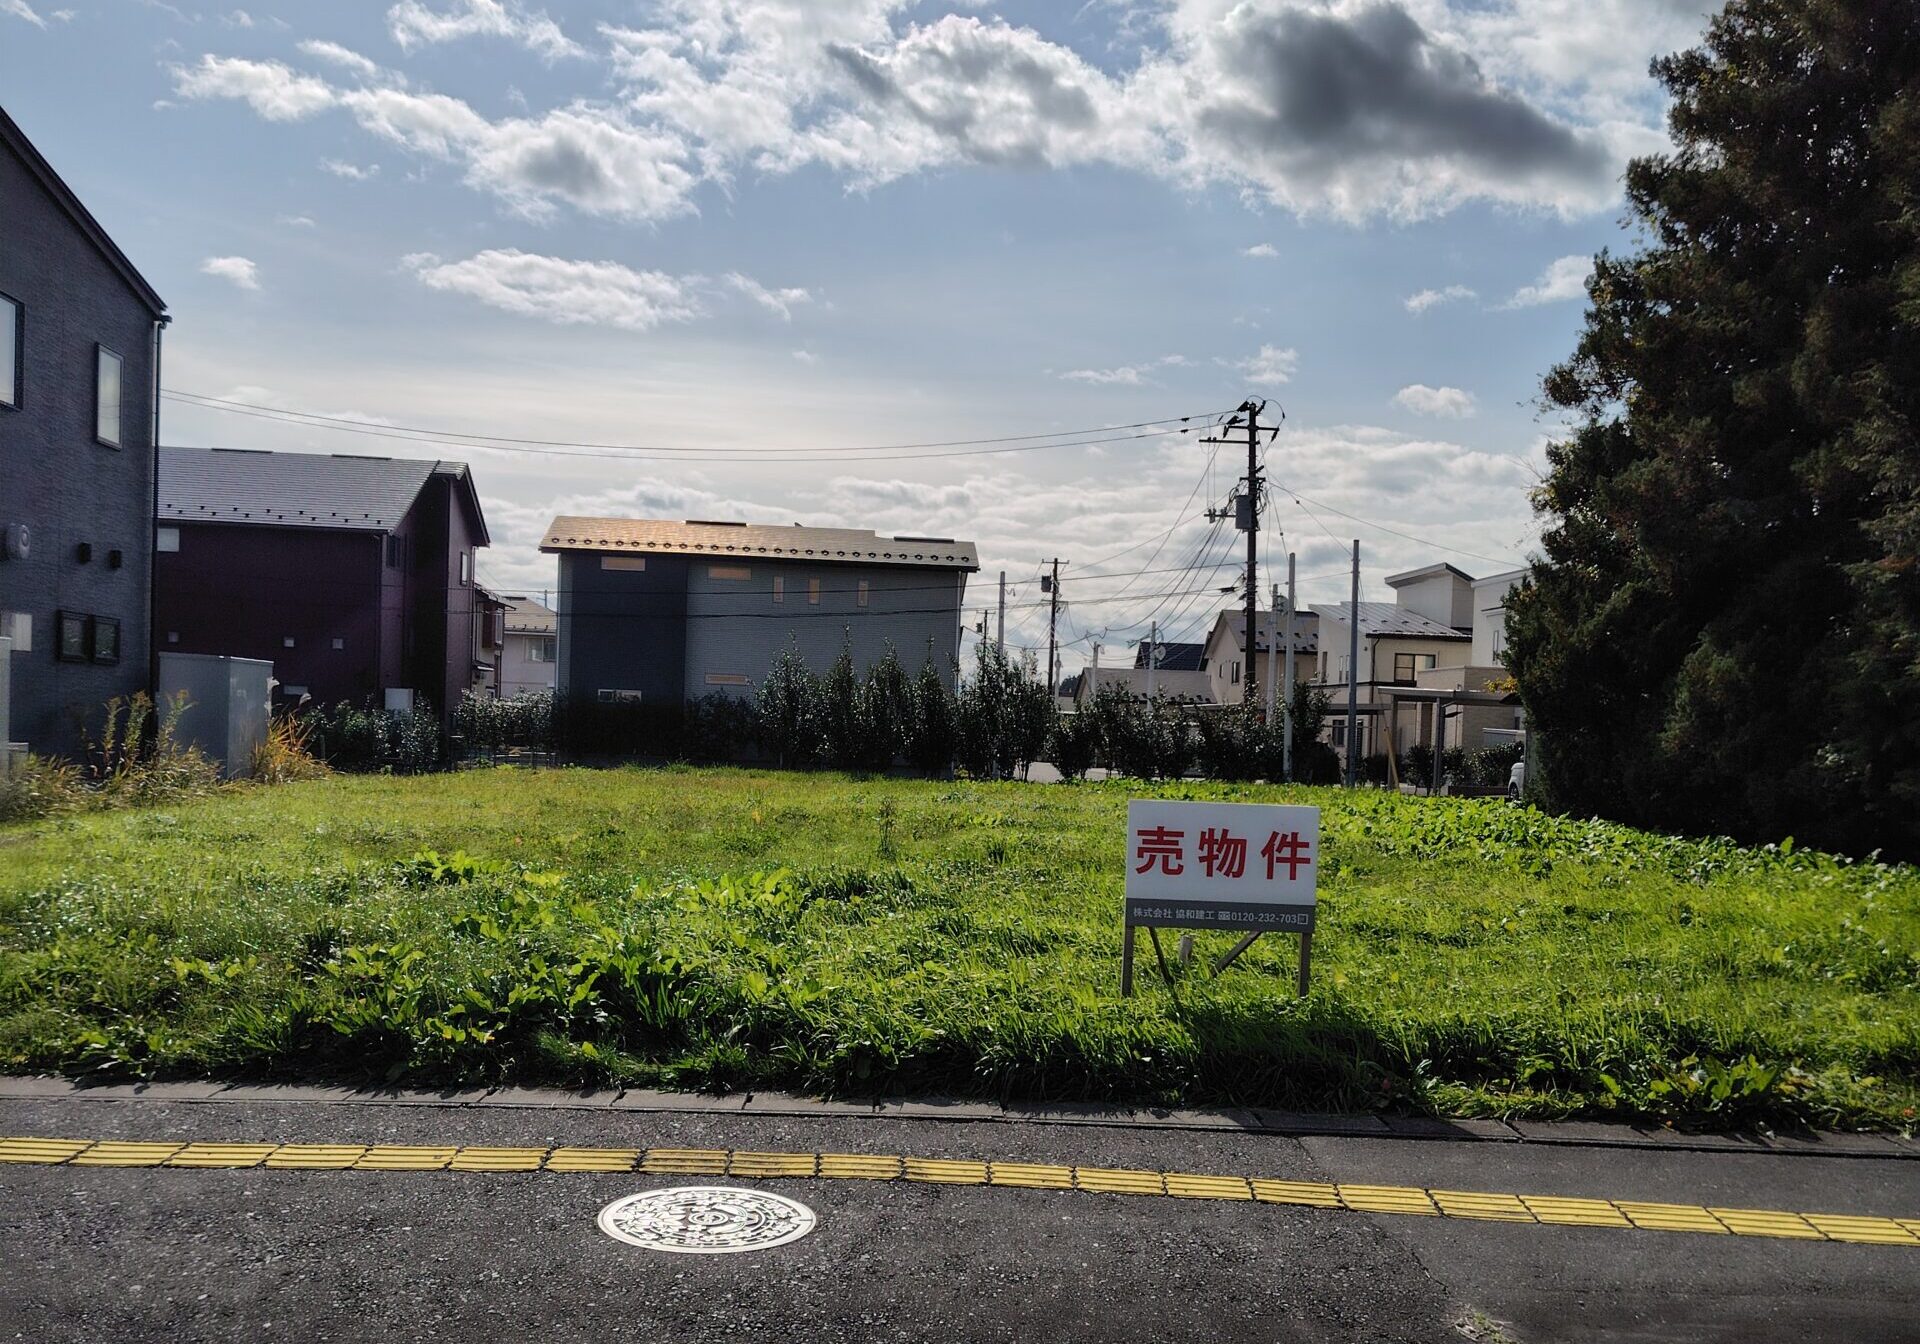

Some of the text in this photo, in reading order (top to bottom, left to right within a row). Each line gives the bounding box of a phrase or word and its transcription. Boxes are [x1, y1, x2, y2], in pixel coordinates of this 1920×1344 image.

[1135, 826, 1311, 881] 売物件
[1133, 907, 1297, 924] 株式会社 協和建工 0120-232-703
